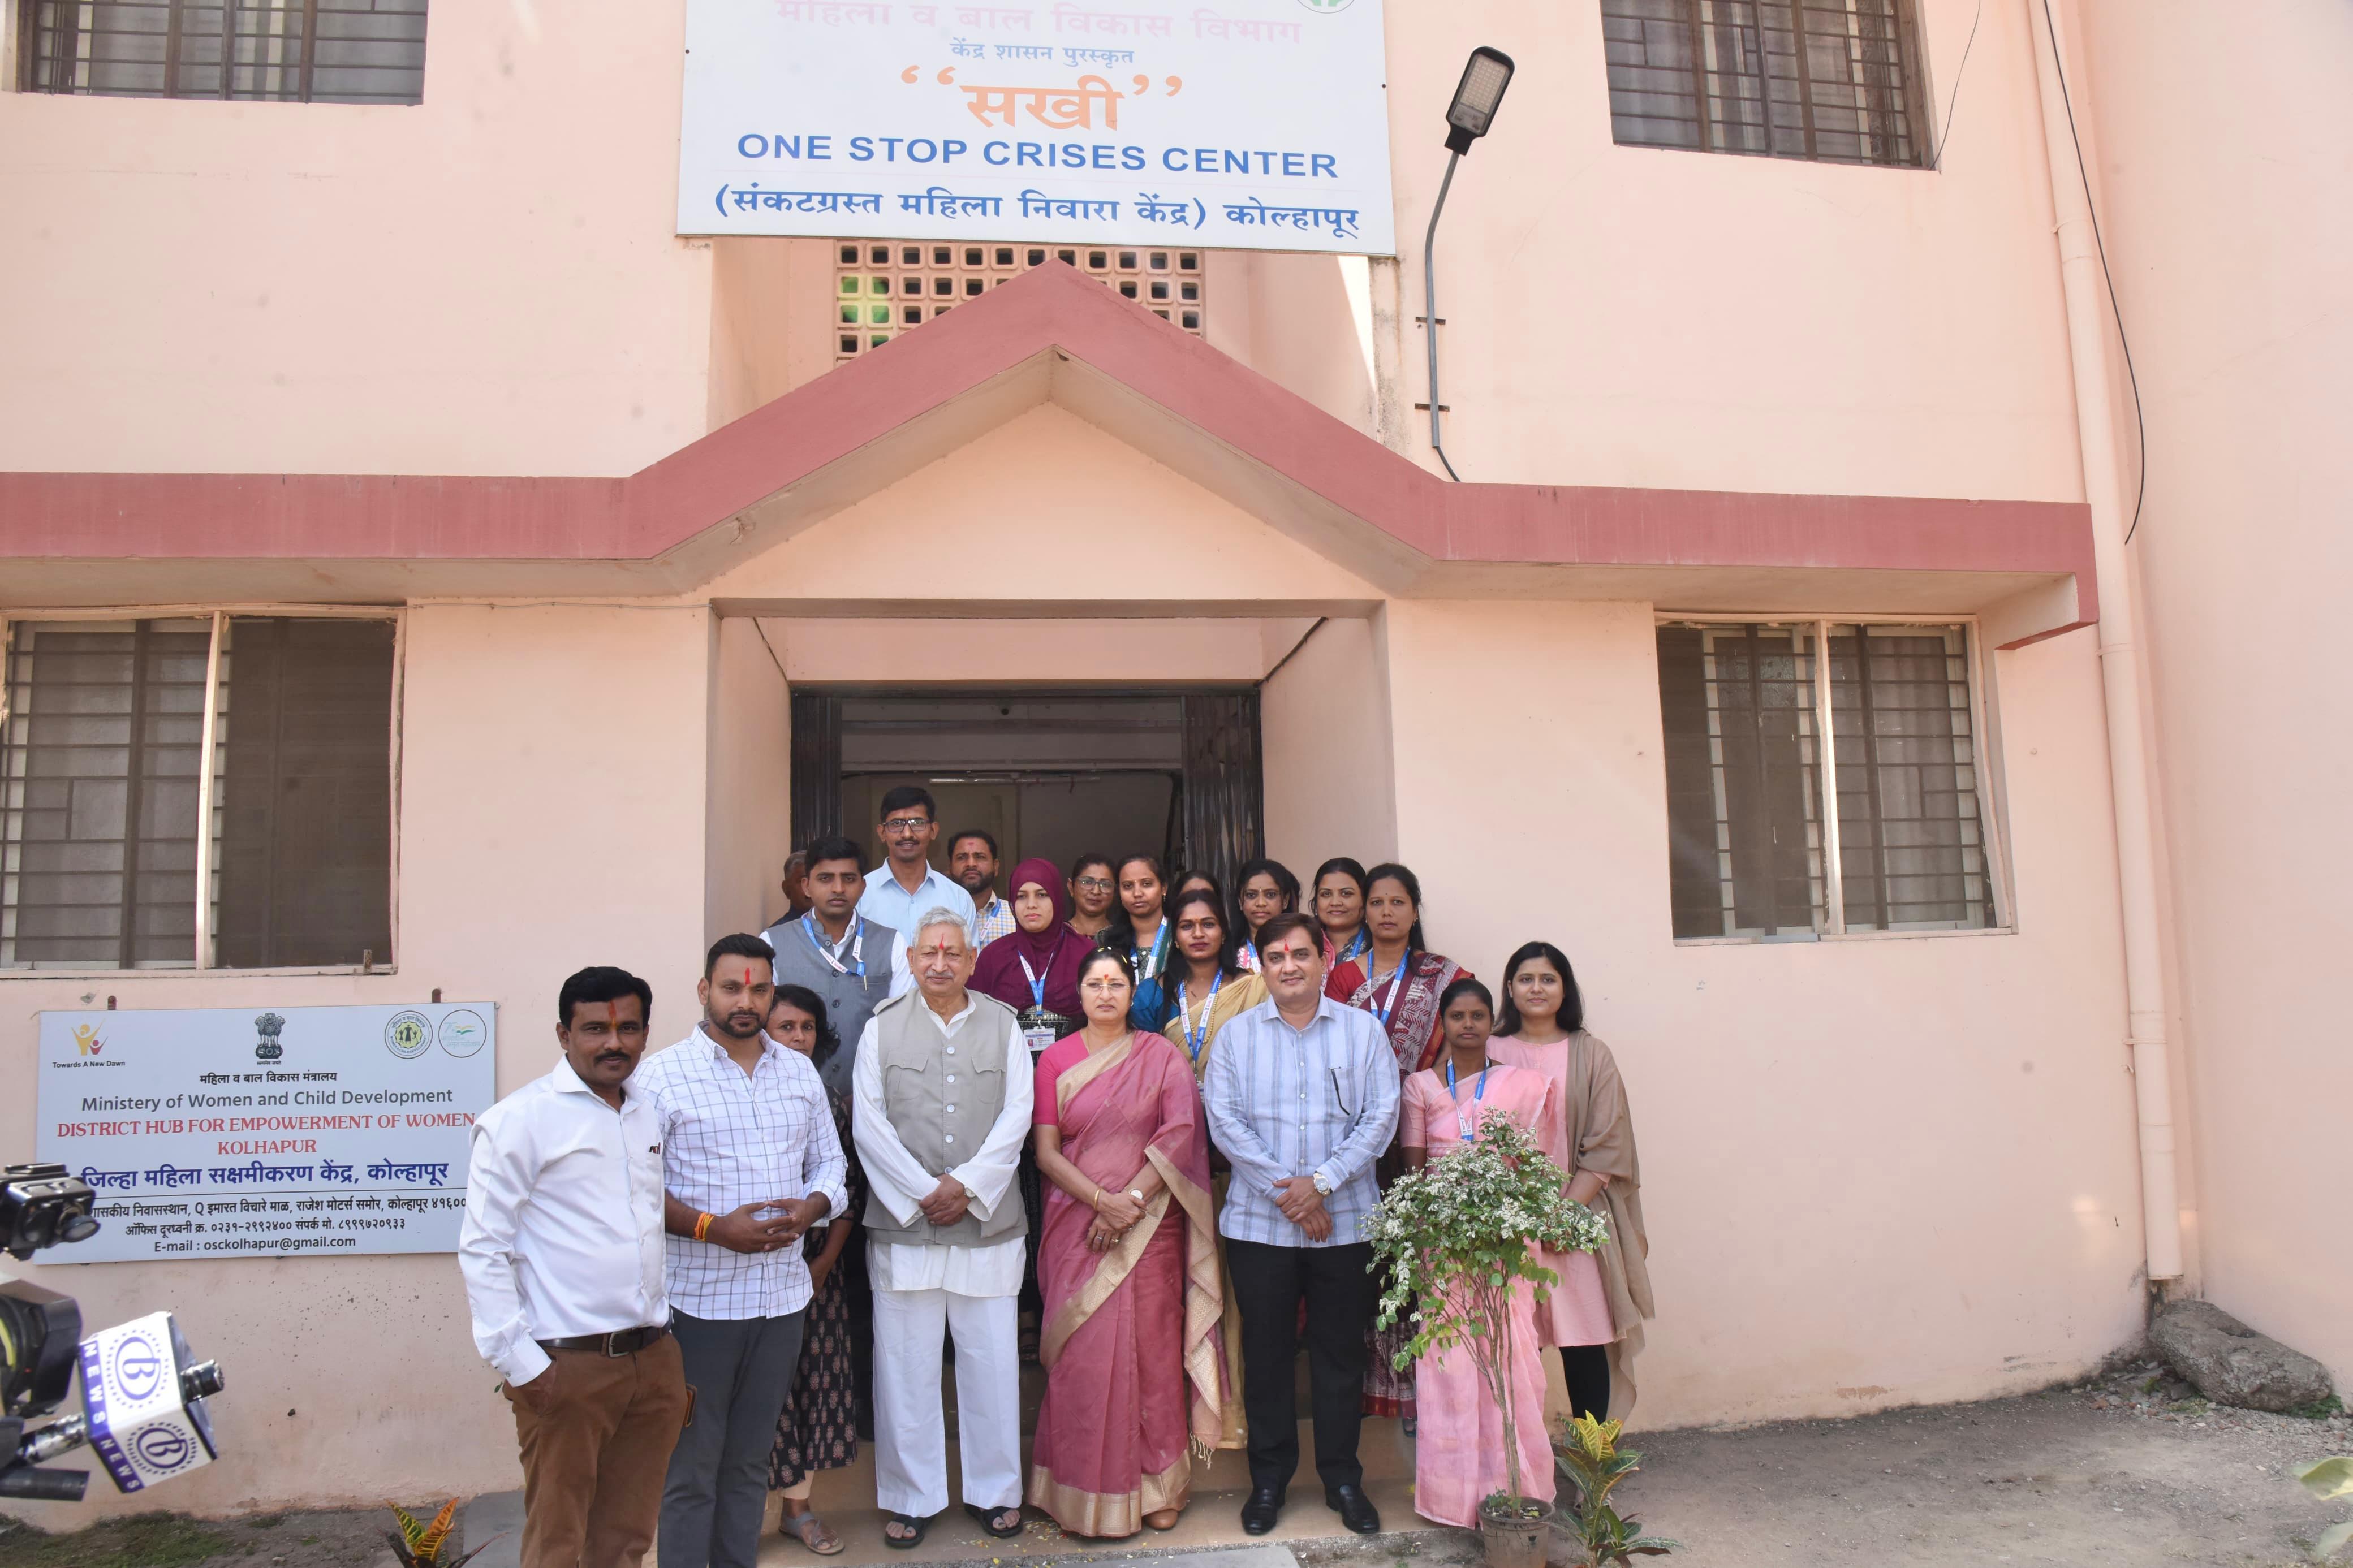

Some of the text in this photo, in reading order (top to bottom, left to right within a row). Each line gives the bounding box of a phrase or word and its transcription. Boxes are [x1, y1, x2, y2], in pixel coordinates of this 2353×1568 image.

[912, 6, 938, 27] व
[955, 7, 1033, 31] बाल
[1050, 2, 1174, 38] विकास
[1191, 8, 1303, 44] विभाग
[950, 37, 1134, 68] केंद्र शासन पुरस्कृत
[738, 134, 1338, 178] ONE STOP CRISES CENTER
[716, 182, 1359, 239] (संकटग्रस्त महिला निवारा केंद्र) कोल्हापूर
[200, 1072, 230, 1085] महिला
[243, 1074, 263, 1082] बाल
[266, 1070, 300, 1082] विकास
[303, 1070, 337, 1081] मंत्रालय
[82, 1090, 453, 1112] Ministery of Women and Child Development
[58, 1113, 475, 1137] DISTRICT HUB FOR EMPOWERMENT OF WOMEN
[218, 1140, 316, 1155] KOLHAPUR
[81, 1157, 449, 1190] जिल्हा महिला सक्षमीकरण केंद्र, कोल्हापूर
[133, 1202, 190, 1216] निवासस्थान,
[195, 1202, 204, 1216] Q
[207, 1203, 235, 1215] इमारत
[240, 1198, 267, 1212] विचारे
[270, 1202, 292, 1213] माळ,
[296, 1198, 324, 1211] राजेश
[326, 1196, 354, 1210] मोटर्स
[356, 1196, 383, 1211] समोर,
[387, 1195, 429, 1213] कोल्हापूर
[322, 1217, 334, 1229] मो.
[155, 1240, 192, 1252] E-mail
[204, 1236, 355, 1251] osckolhapur@gmail.com
[84, 1342, 106, 1424] NEWS
[101, 1438, 139, 1489] NEWS
